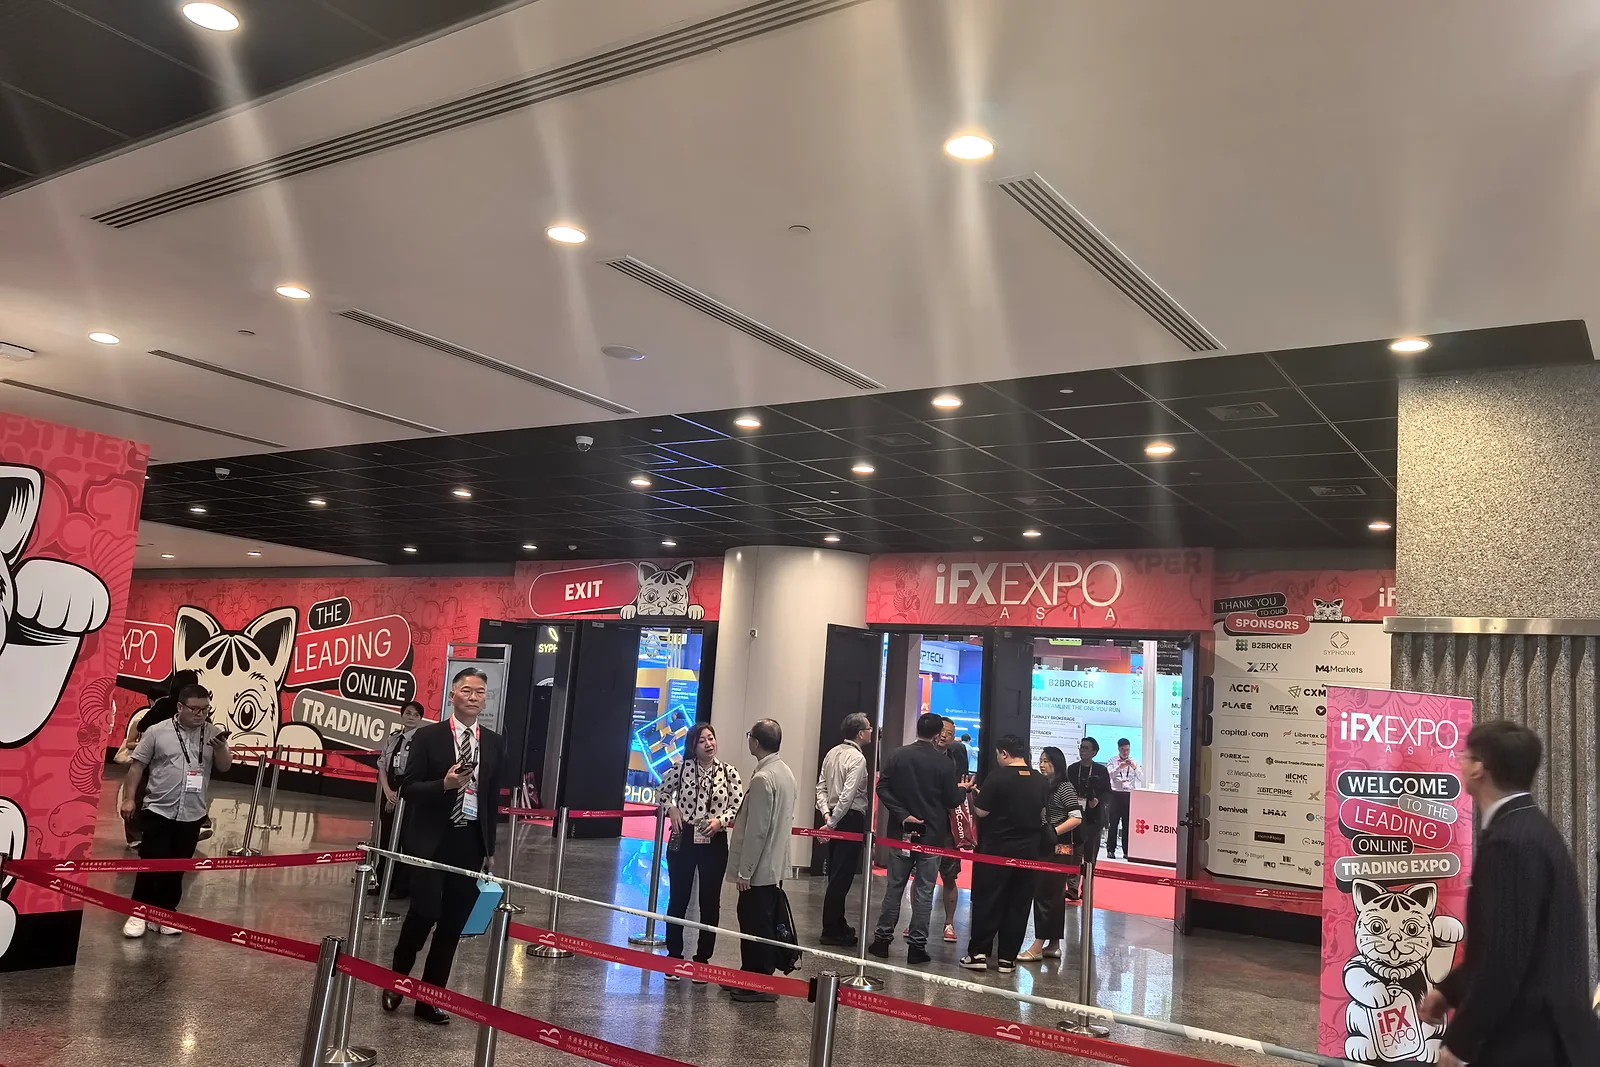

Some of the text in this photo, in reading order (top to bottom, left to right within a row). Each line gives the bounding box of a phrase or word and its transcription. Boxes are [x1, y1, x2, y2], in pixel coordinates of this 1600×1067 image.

[565, 580, 603, 601] EXIT
[935, 560, 1122, 607] iFXEXPO
[1220, 597, 1277, 611] THANK YOU
[1270, 608, 1285, 616] OUR
[316, 603, 343, 625] THE
[1000, 607, 1116, 621] ASIA
[1235, 618, 1300, 630] SPONSORS
[294, 628, 392, 674] LEADING
[1251, 642, 1292, 650] B2BROKER
[1259, 662, 1279, 672] ZFX
[1315, 665, 1363, 674] M4Markets
[346, 671, 408, 701] ONLINE
[1048, 679, 1095, 689] B2BROKER
[1303, 689, 1327, 697] CXM
[1269, 704, 1299, 712] MEGA
[302, 698, 385, 742] TRADING
[1340, 712, 1459, 749] iFXEXPO
[1385, 744, 1456, 759] ASIA
[1233, 770, 1267, 779] MetaQuotes
[1347, 776, 1449, 795] WELCOME
[1406, 798, 1449, 820] TO THE
[1354, 805, 1438, 840] LEADING
[1358, 838, 1409, 853] ONLINE
[1341, 858, 1451, 876] TRADING EXPO
[1376, 1005, 1412, 1034] iFX
[1382, 1027, 1416, 1048] EXPO
[1028, 1037, 1131, 1063] Hong Kong Convention and Exhibition Centre
